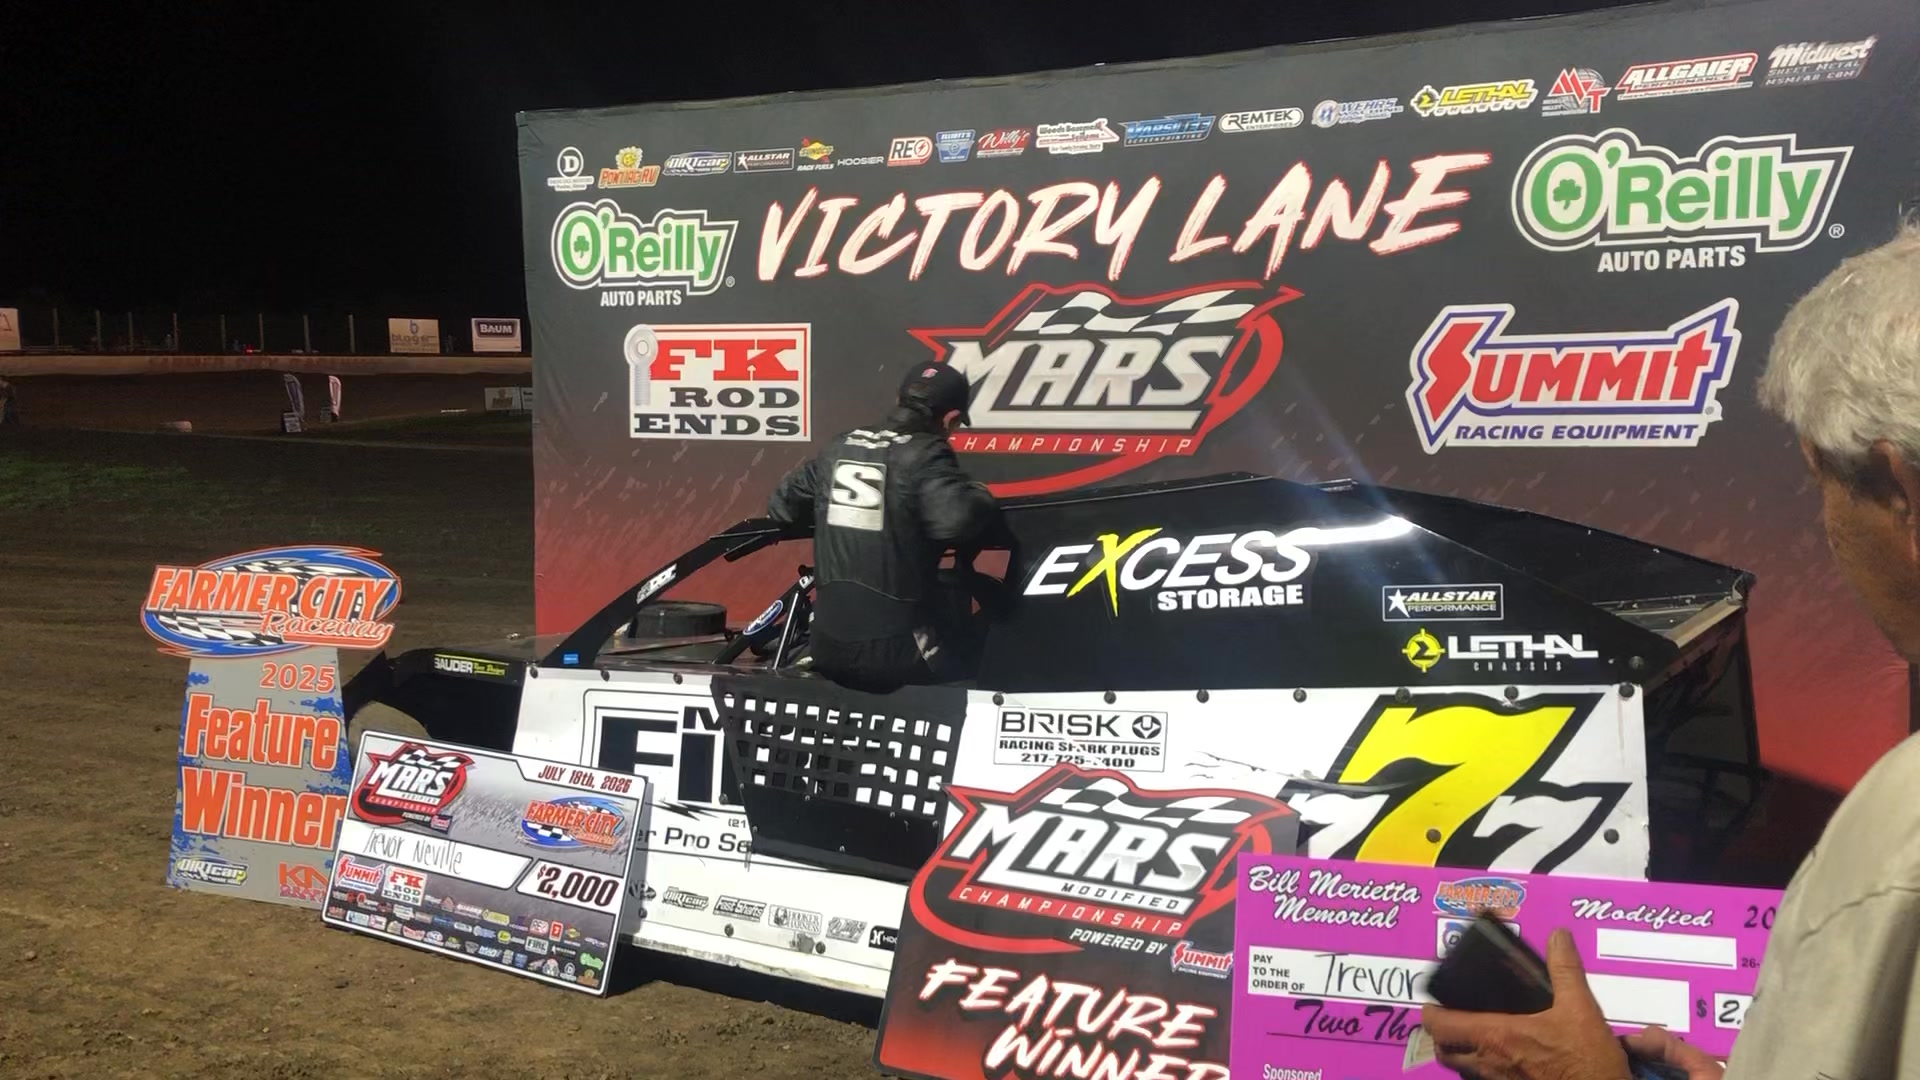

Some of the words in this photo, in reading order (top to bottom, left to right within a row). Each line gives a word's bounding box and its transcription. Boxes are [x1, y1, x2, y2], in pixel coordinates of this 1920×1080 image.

[1768, 35, 1878, 69] Midwest
[1623, 57, 1753, 90] ALLGAIER
[1815, 61, 1860, 71] METAL
[1440, 81, 1533, 106] LETHAL
[1227, 110, 1294, 129] REMTEK
[564, 155, 580, 172] D
[747, 152, 790, 161] ALLSTAR
[797, 164, 814, 172] RACE
[815, 163, 835, 171] FUELS
[837, 156, 885, 166] HOOSIER
[643, 166, 657, 184] RV
[1530, 144, 1823, 232] O'Reilly
[757, 175, 1163, 282] VICTORY
[1168, 152, 1494, 281] LANE
[560, 209, 724, 282] O'Reilly
[1597, 249, 1661, 272] AUTO
[1666, 245, 1746, 269] PARTS
[600, 291, 636, 307] AUTO
[637, 290, 682, 305] PARTS
[479, 323, 513, 334] BAUM
[650, 339, 799, 381] FK
[1424, 323, 1714, 422] SUMMIT
[669, 386, 800, 408] ROD
[947, 338, 1232, 430] MARS
[633, 413, 801, 436] ENDS
[1454, 425, 1544, 440] RACING
[1551, 424, 1699, 440] EQUIPMENT
[949, 437, 1192, 454] HAMPIONSHIP
[832, 464, 884, 507] S
[1023, 527, 1321, 617] EXCESS
[147, 568, 298, 612] FARMER
[299, 575, 391, 621] CITY
[1157, 583, 1304, 612] STORAGE
[1406, 590, 1497, 602] ALLSTAR
[1406, 603, 1497, 613] PERFORMANCE
[260, 609, 395, 640] Raceway
[1448, 633, 1599, 660] LETHAL
[259, 661, 336, 693] 2025
[1473, 661, 1562, 671] CHASSIS
[183, 692, 341, 772] Feature
[1000, 711, 1121, 738] BRISK
[999, 739, 1055, 752] RACING
[1111, 745, 1161, 756] PLUGS
[1020, 753, 1136, 768] 217-725-400
[367, 760, 455, 798] MARS
[537, 764, 567, 782] JULY
[568, 769, 596, 789] 18th,
[181, 766, 348, 851] Winner
[525, 800, 586, 828] FARMER
[584, 811, 621, 837] CITY
[664, 826, 710, 850] Pro
[951, 801, 1232, 895] MARS
[413, 838, 463, 876] Neville
[389, 870, 424, 889] FK
[393, 884, 421, 897] ROD
[537, 864, 620, 908] $2,000
[1248, 864, 1302, 893] Bill
[1308, 869, 1421, 904] Merietta
[1438, 883, 1490, 902] FARMER
[383, 889, 420, 904] ENDS
[716, 899, 736, 914] Fast
[1060, 882, 1182, 911] MODIFIED
[958, 886, 1185, 935] CHAMPIONSHIP
[1273, 894, 1401, 929] Memorial
[1571, 897, 1713, 930] Modified
[1069, 927, 1145, 952] POWERED
[1145, 941, 1168, 956] BY
[1172, 941, 1234, 971] SUMMIT
[1253, 953, 1273, 965] PAY
[1252, 965, 1266, 977] TO
[1269, 967, 1291, 979] THE
[1252, 978, 1289, 991] ORDER
[1291, 981, 1306, 992] OF
[1314, 953, 1426, 1001] Trevor
[918, 958, 1219, 1048] FEATURE
[1696, 998, 1708, 1019] $
[1293, 999, 1363, 1036] Two
